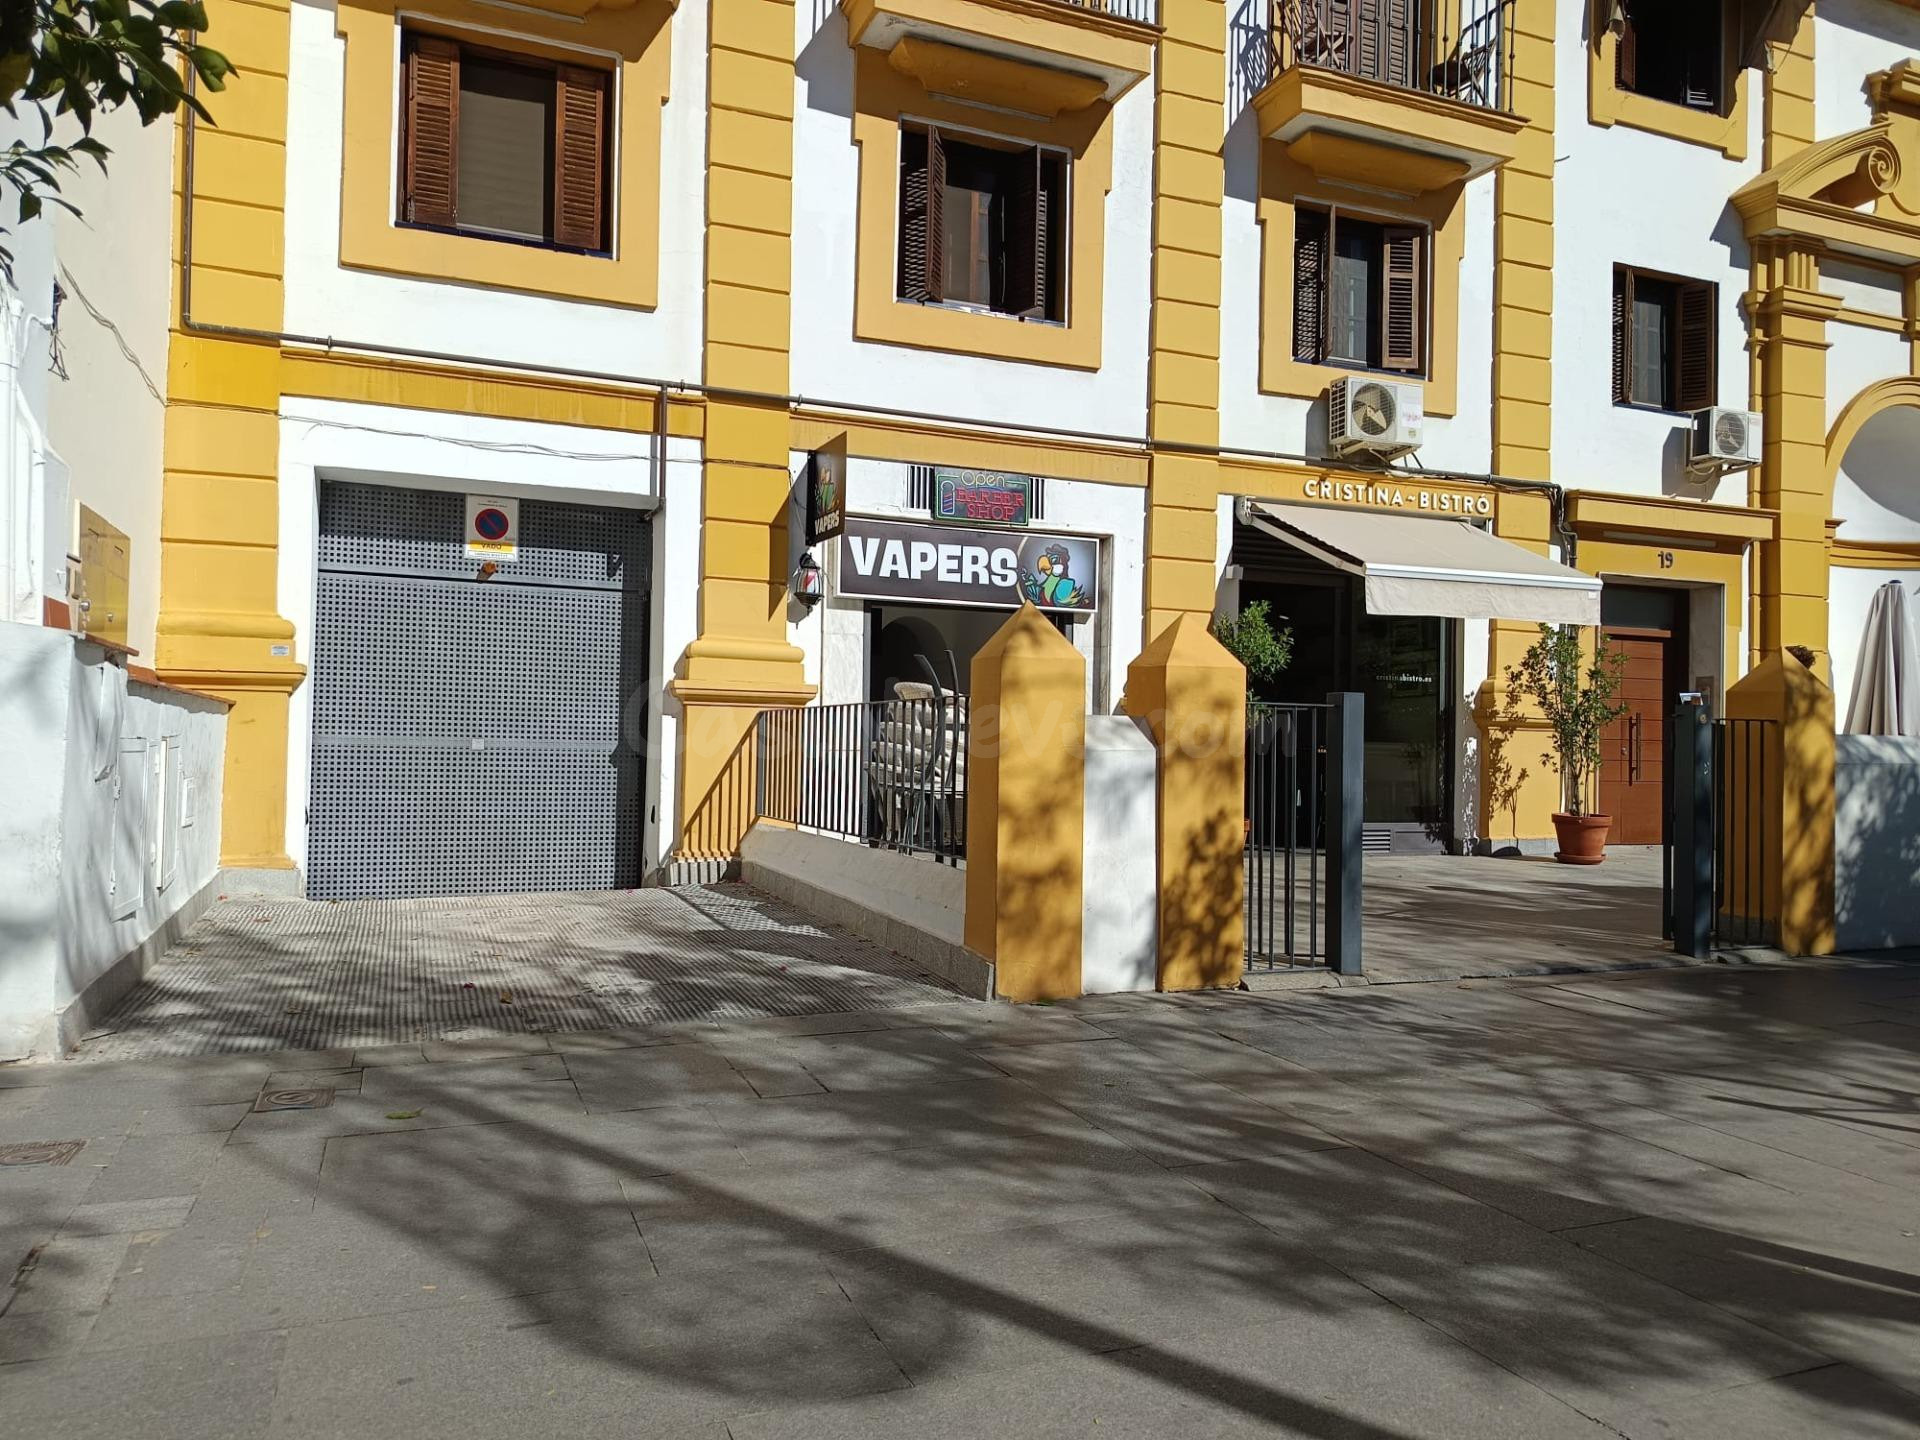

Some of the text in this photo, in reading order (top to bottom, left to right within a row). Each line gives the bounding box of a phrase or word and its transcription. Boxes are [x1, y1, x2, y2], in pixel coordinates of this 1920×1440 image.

[961, 470, 1005, 488] Open
[955, 487, 1025, 507] BARBER
[967, 503, 1016, 521] SHOP
[815, 510, 840, 536] VAPERS
[848, 536, 1018, 588] VAPERS
[1657, 550, 1674, 569] 19
